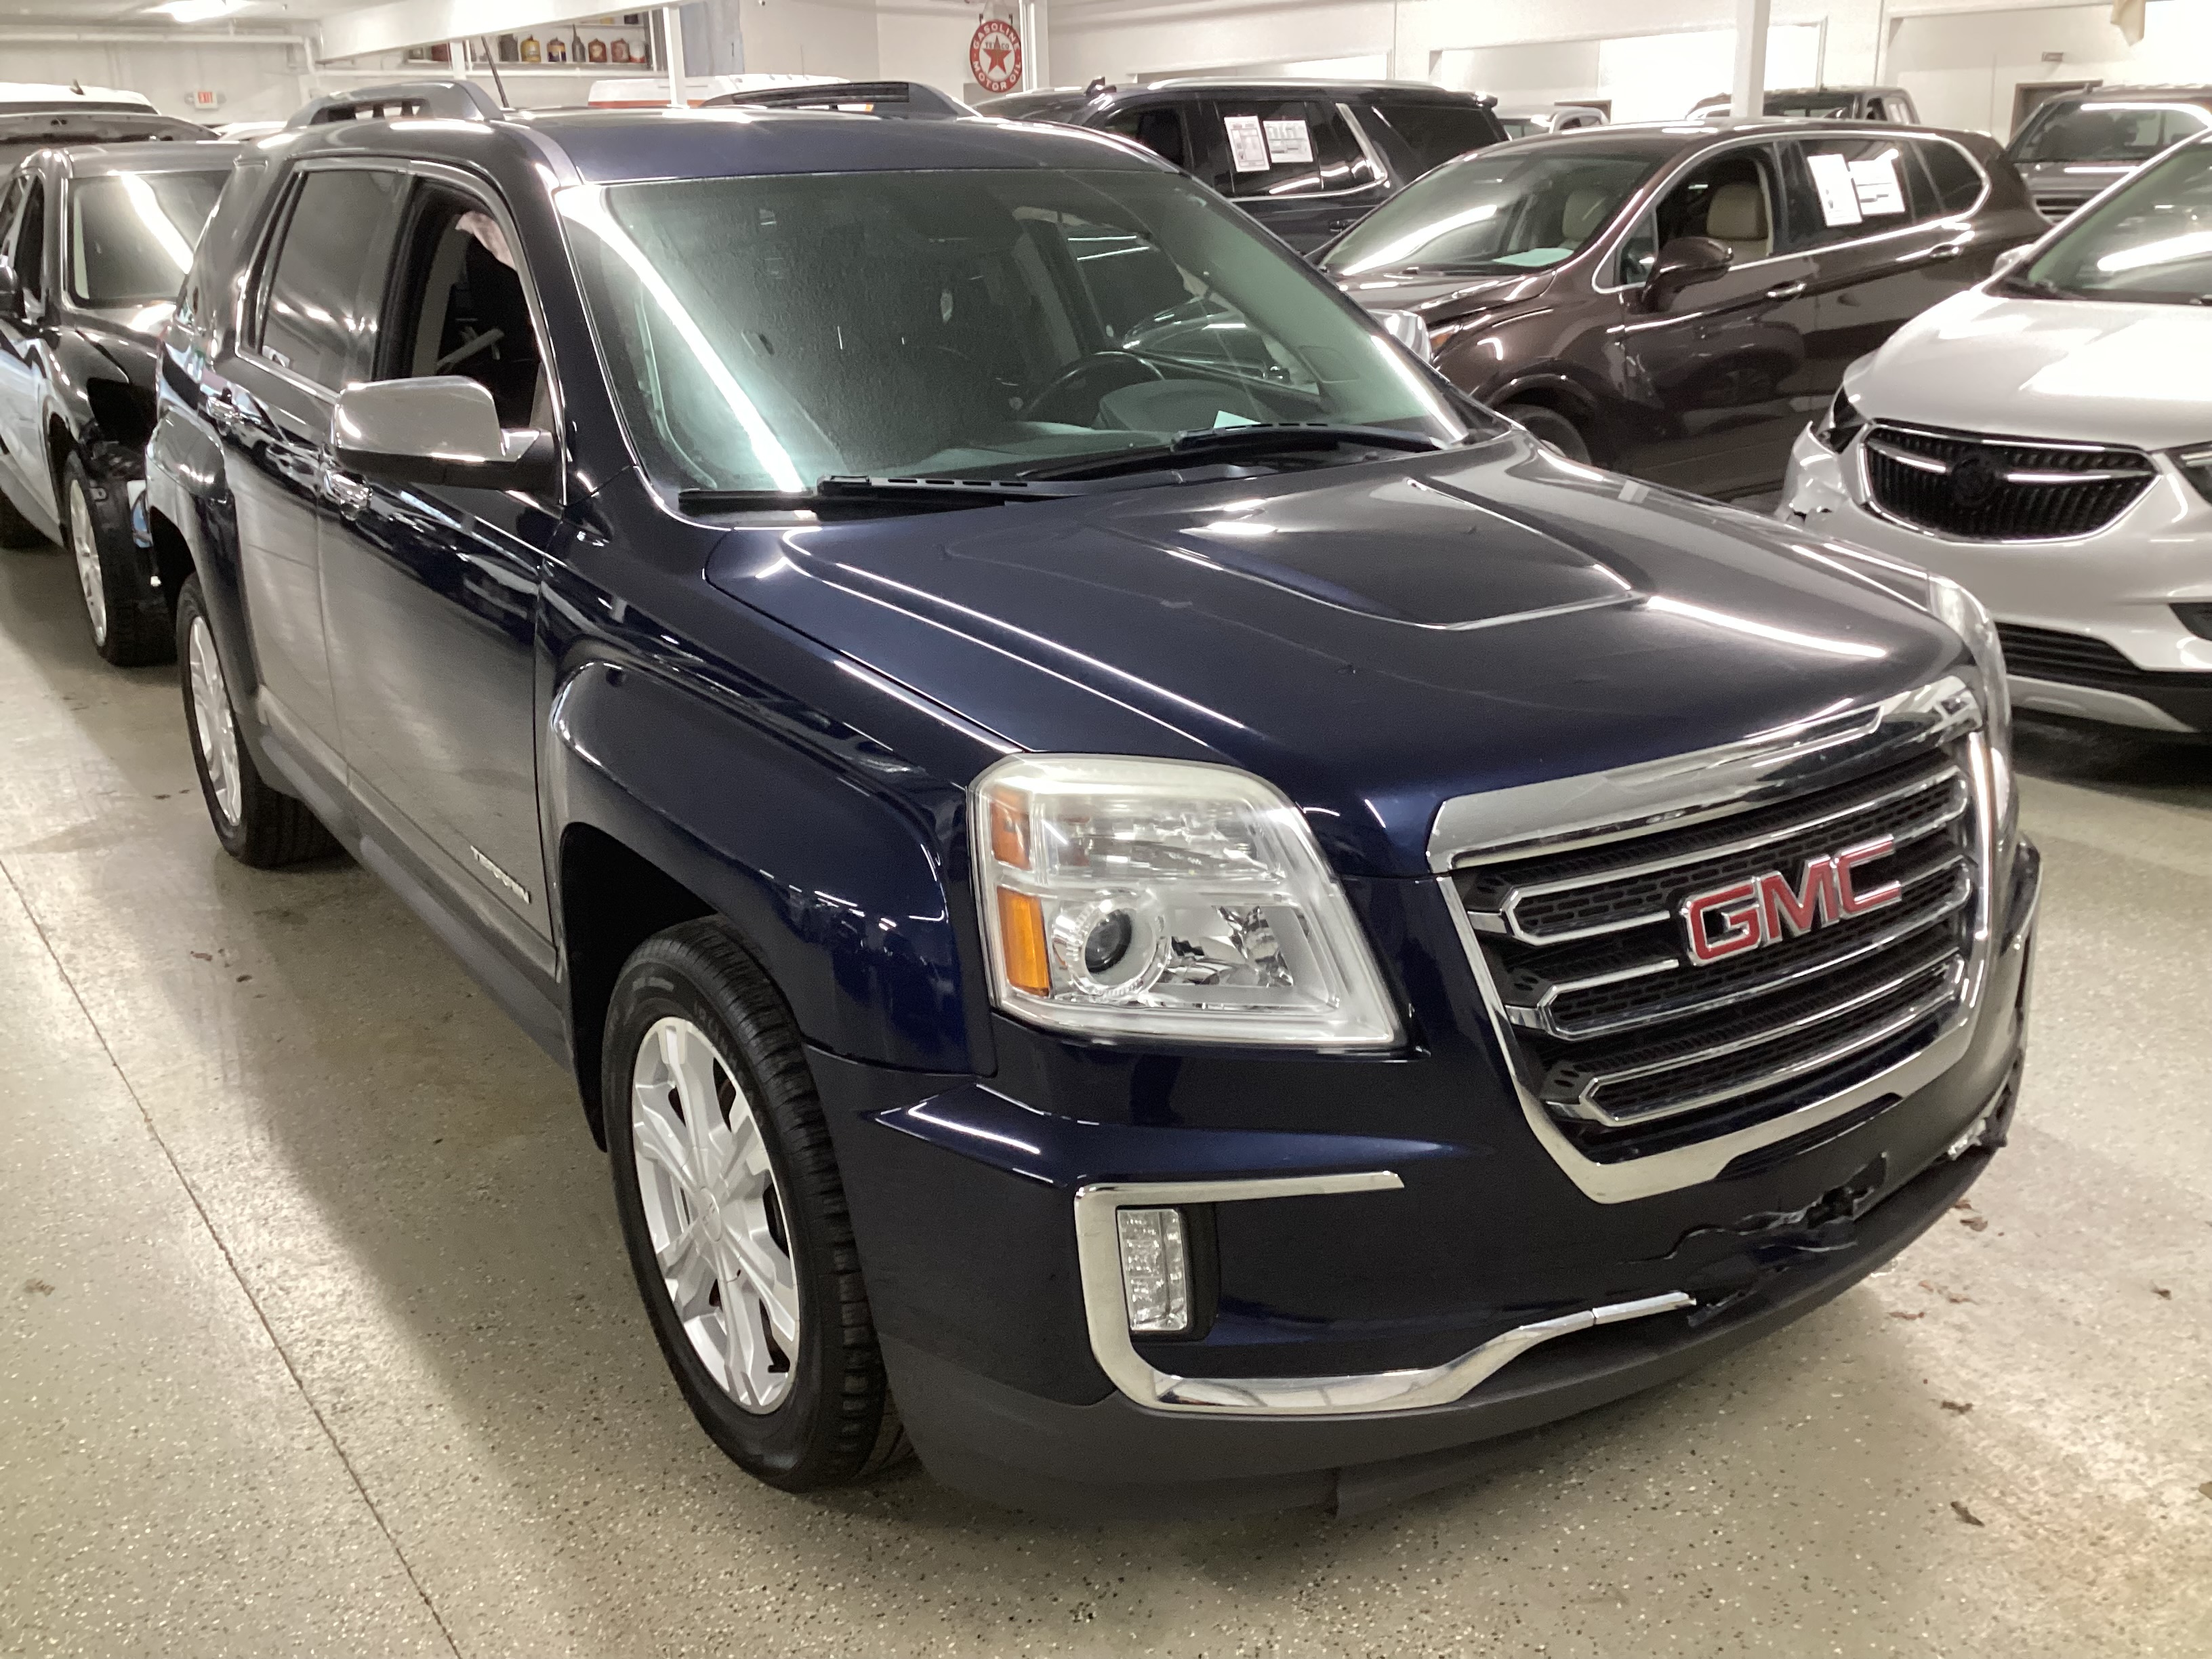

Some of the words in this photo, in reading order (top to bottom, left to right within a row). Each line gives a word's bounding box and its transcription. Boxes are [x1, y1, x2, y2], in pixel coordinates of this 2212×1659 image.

[973, 60, 1006, 91] MOTOR
[1009, 62, 1021, 83] OIL
[1681, 834, 1902, 966] GMC
